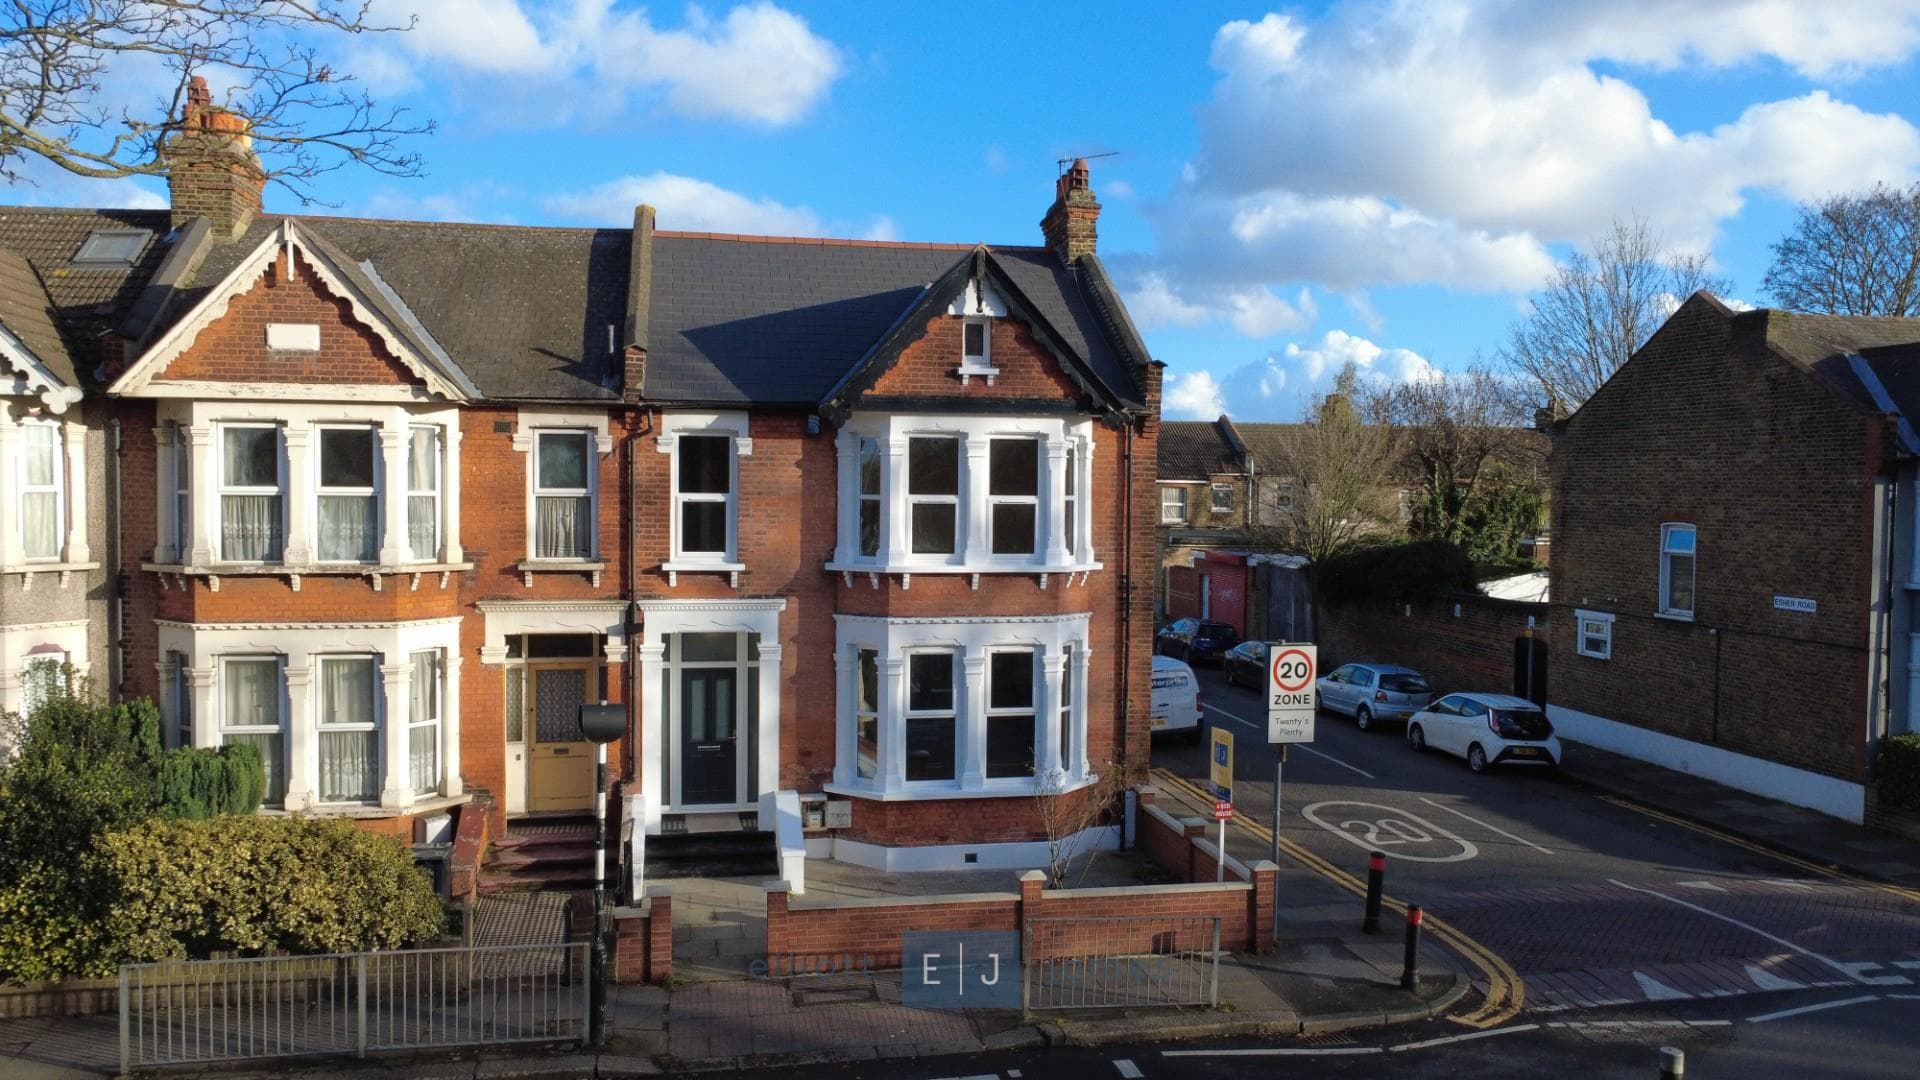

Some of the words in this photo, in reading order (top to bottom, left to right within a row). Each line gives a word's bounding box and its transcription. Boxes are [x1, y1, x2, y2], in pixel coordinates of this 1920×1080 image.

[1797, 601, 1815, 610] ROAD
[1280, 662, 1308, 679] 20
[1274, 694, 1311, 705] ZONE
[1340, 819, 1433, 845] 20
